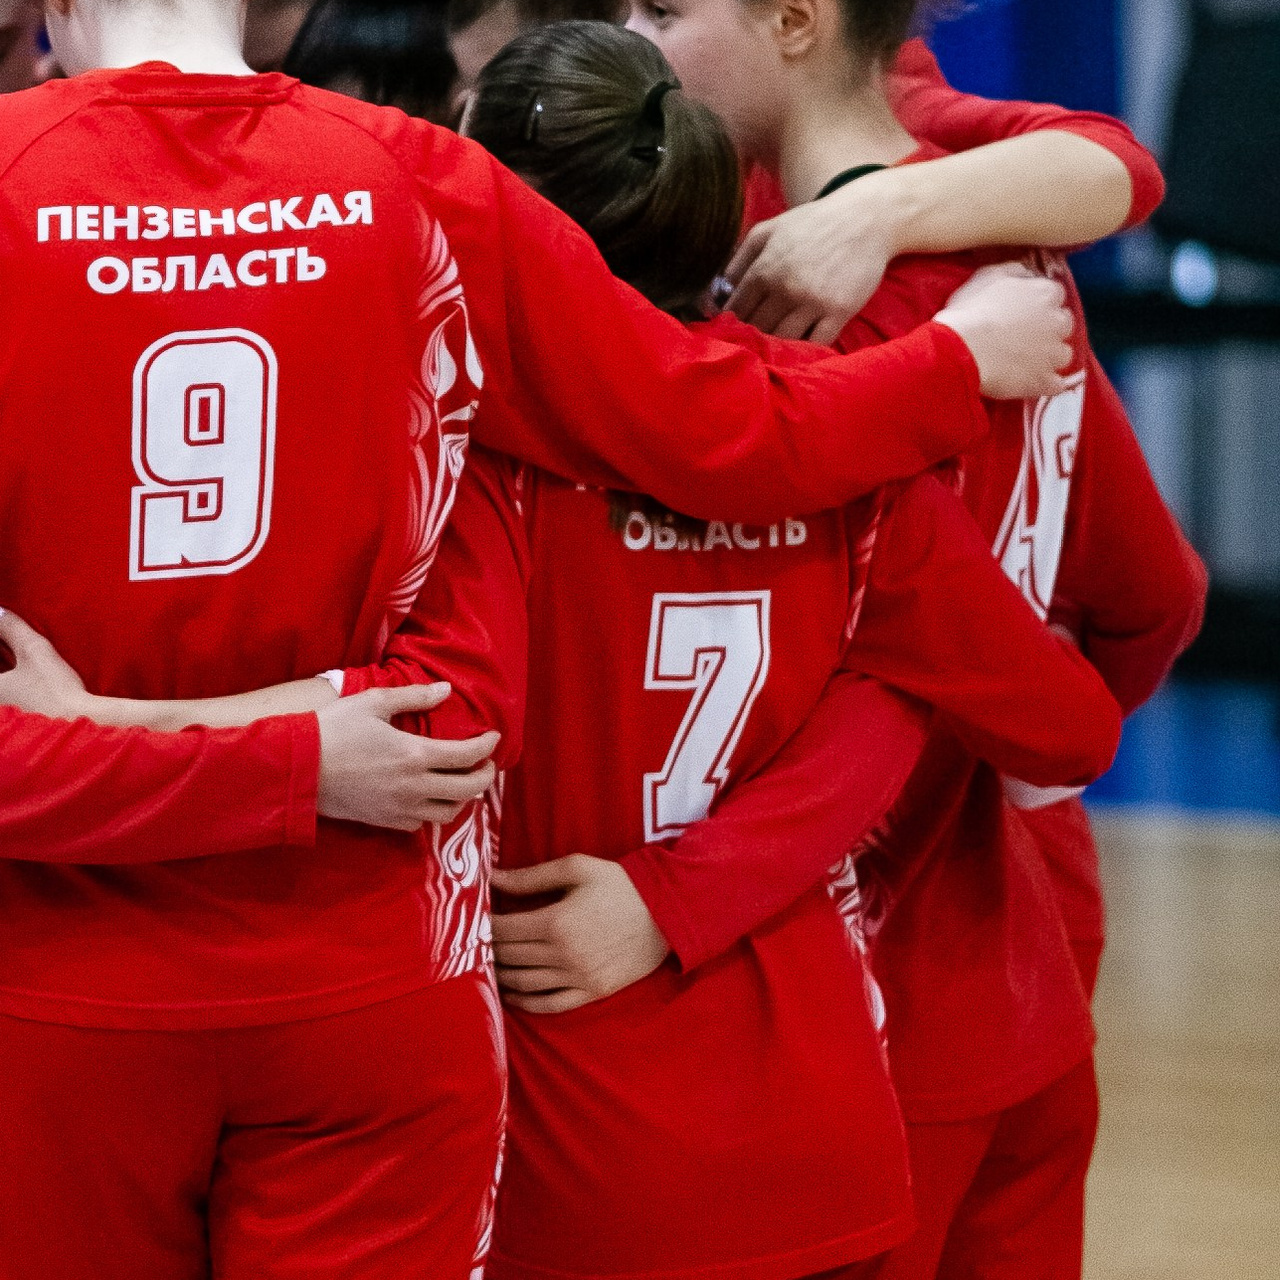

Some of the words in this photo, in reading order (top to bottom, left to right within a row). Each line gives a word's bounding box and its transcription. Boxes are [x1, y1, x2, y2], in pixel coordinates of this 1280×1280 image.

[37, 190, 373, 242] ПЕНЗЕНСКАЯ
[86, 246, 327, 295] ОБЛАСТЬ
[128, 327, 279, 582] 9
[643, 590, 771, 843] 7
